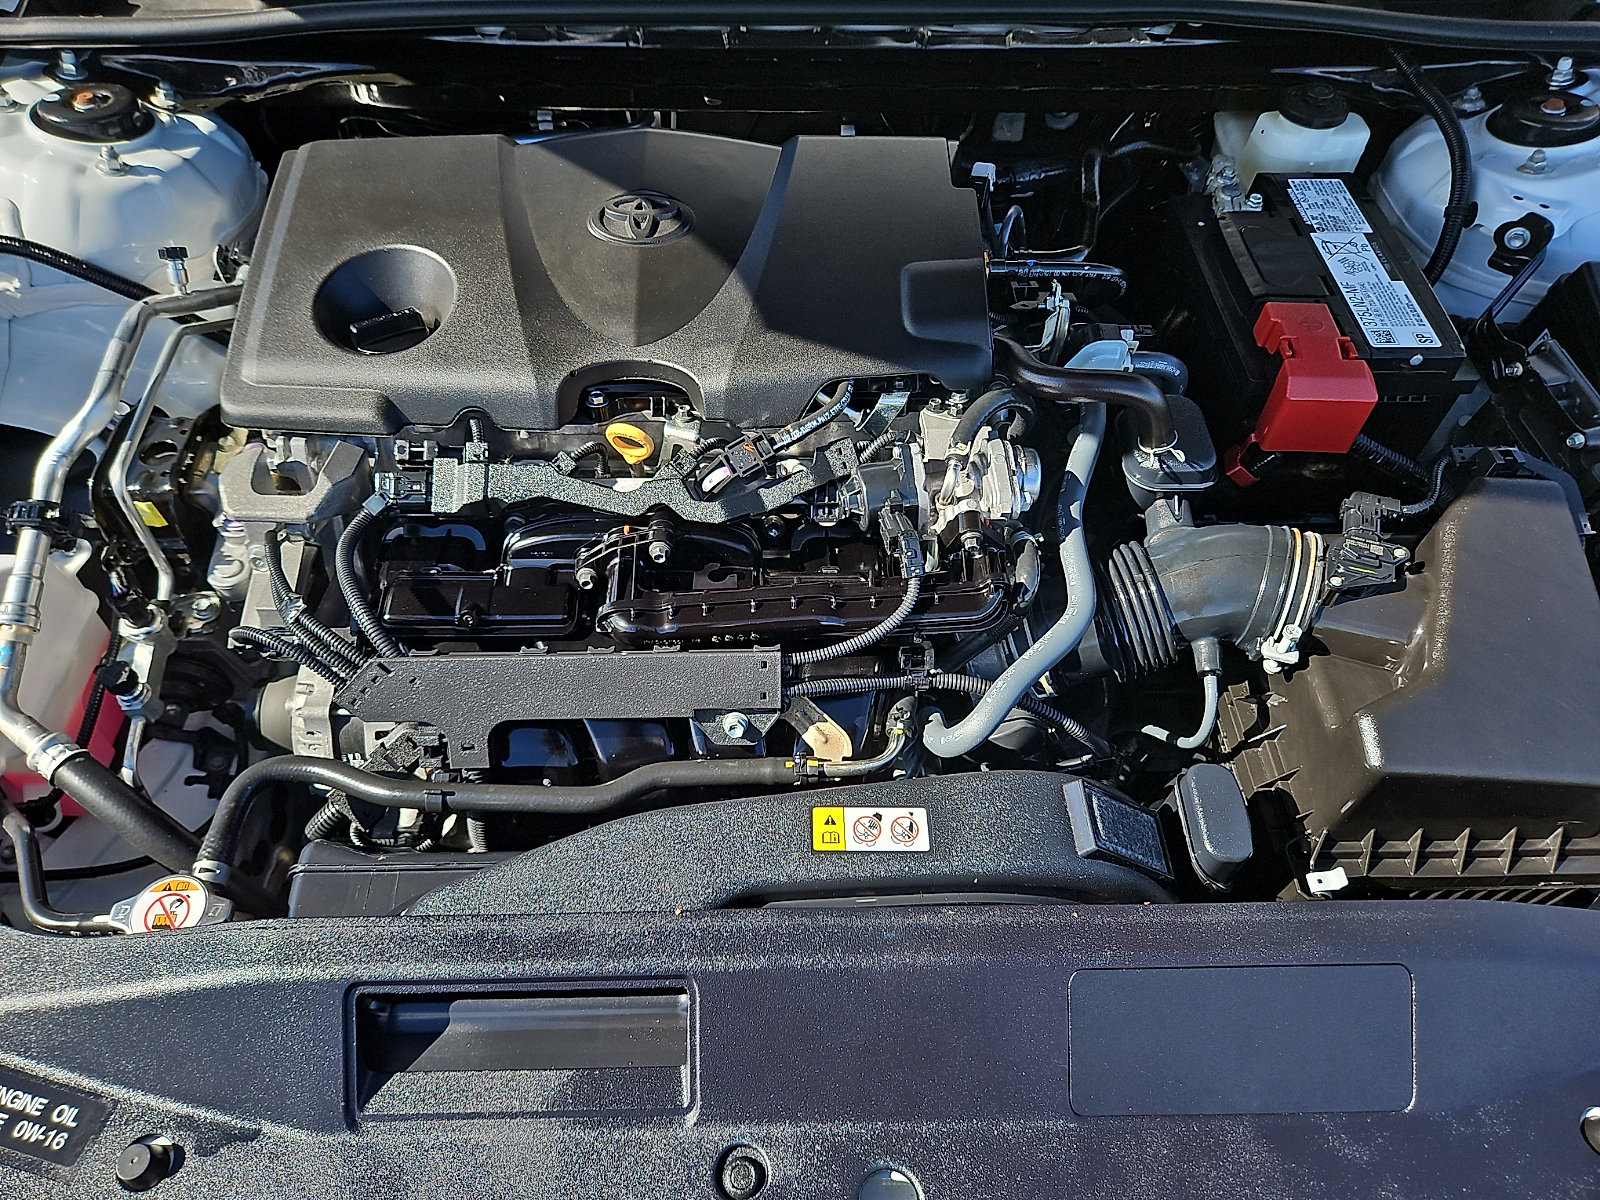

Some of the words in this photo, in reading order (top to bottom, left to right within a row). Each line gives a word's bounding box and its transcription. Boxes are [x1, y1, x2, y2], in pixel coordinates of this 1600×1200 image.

[1360, 243, 1371, 252] Pb
[1418, 333, 1433, 345] SP
[0, 1085, 49, 1116] NGINE
[52, 1104, 80, 1128] OIL
[13, 1120, 69, 1150] 0W-16
